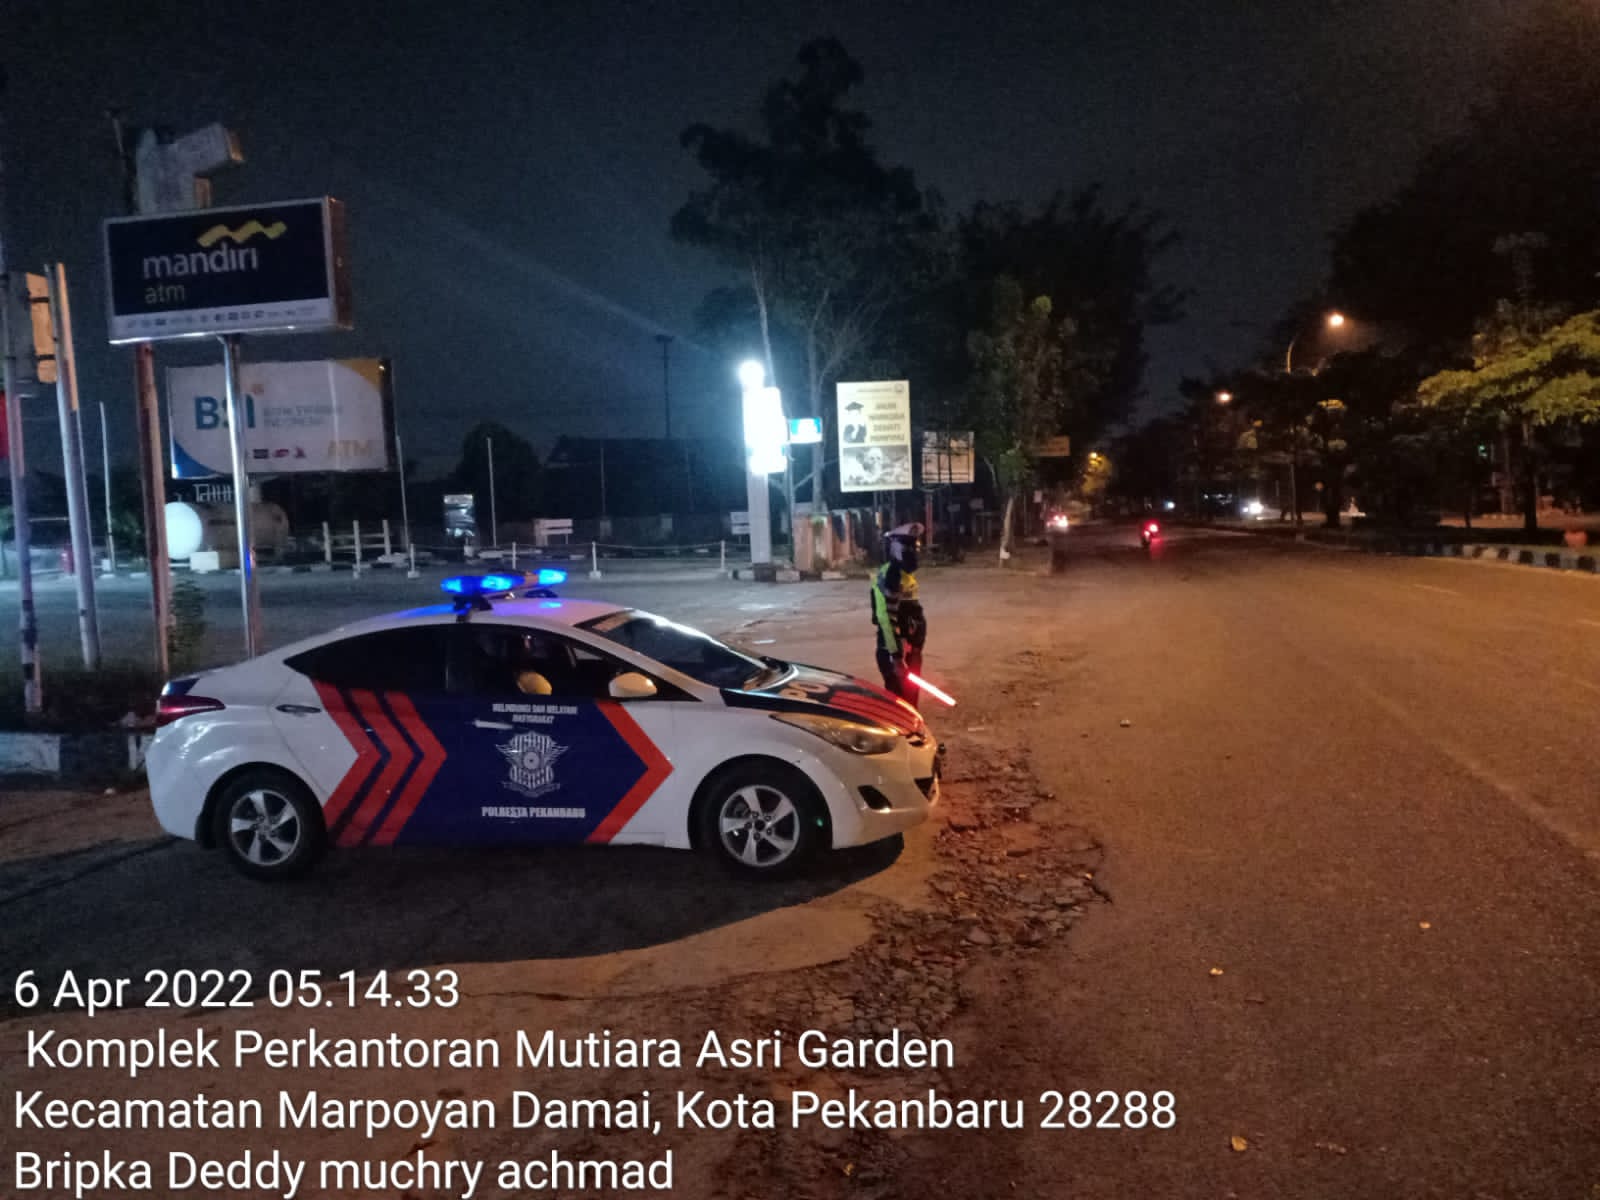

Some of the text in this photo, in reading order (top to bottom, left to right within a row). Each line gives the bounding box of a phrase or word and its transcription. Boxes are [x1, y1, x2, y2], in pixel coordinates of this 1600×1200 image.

[142, 242, 259, 280] mandiri
[144, 282, 186, 305] atm
[194, 393, 256, 431] BI
[481, 806, 587, 819] POLRESTA PEKANBARU
